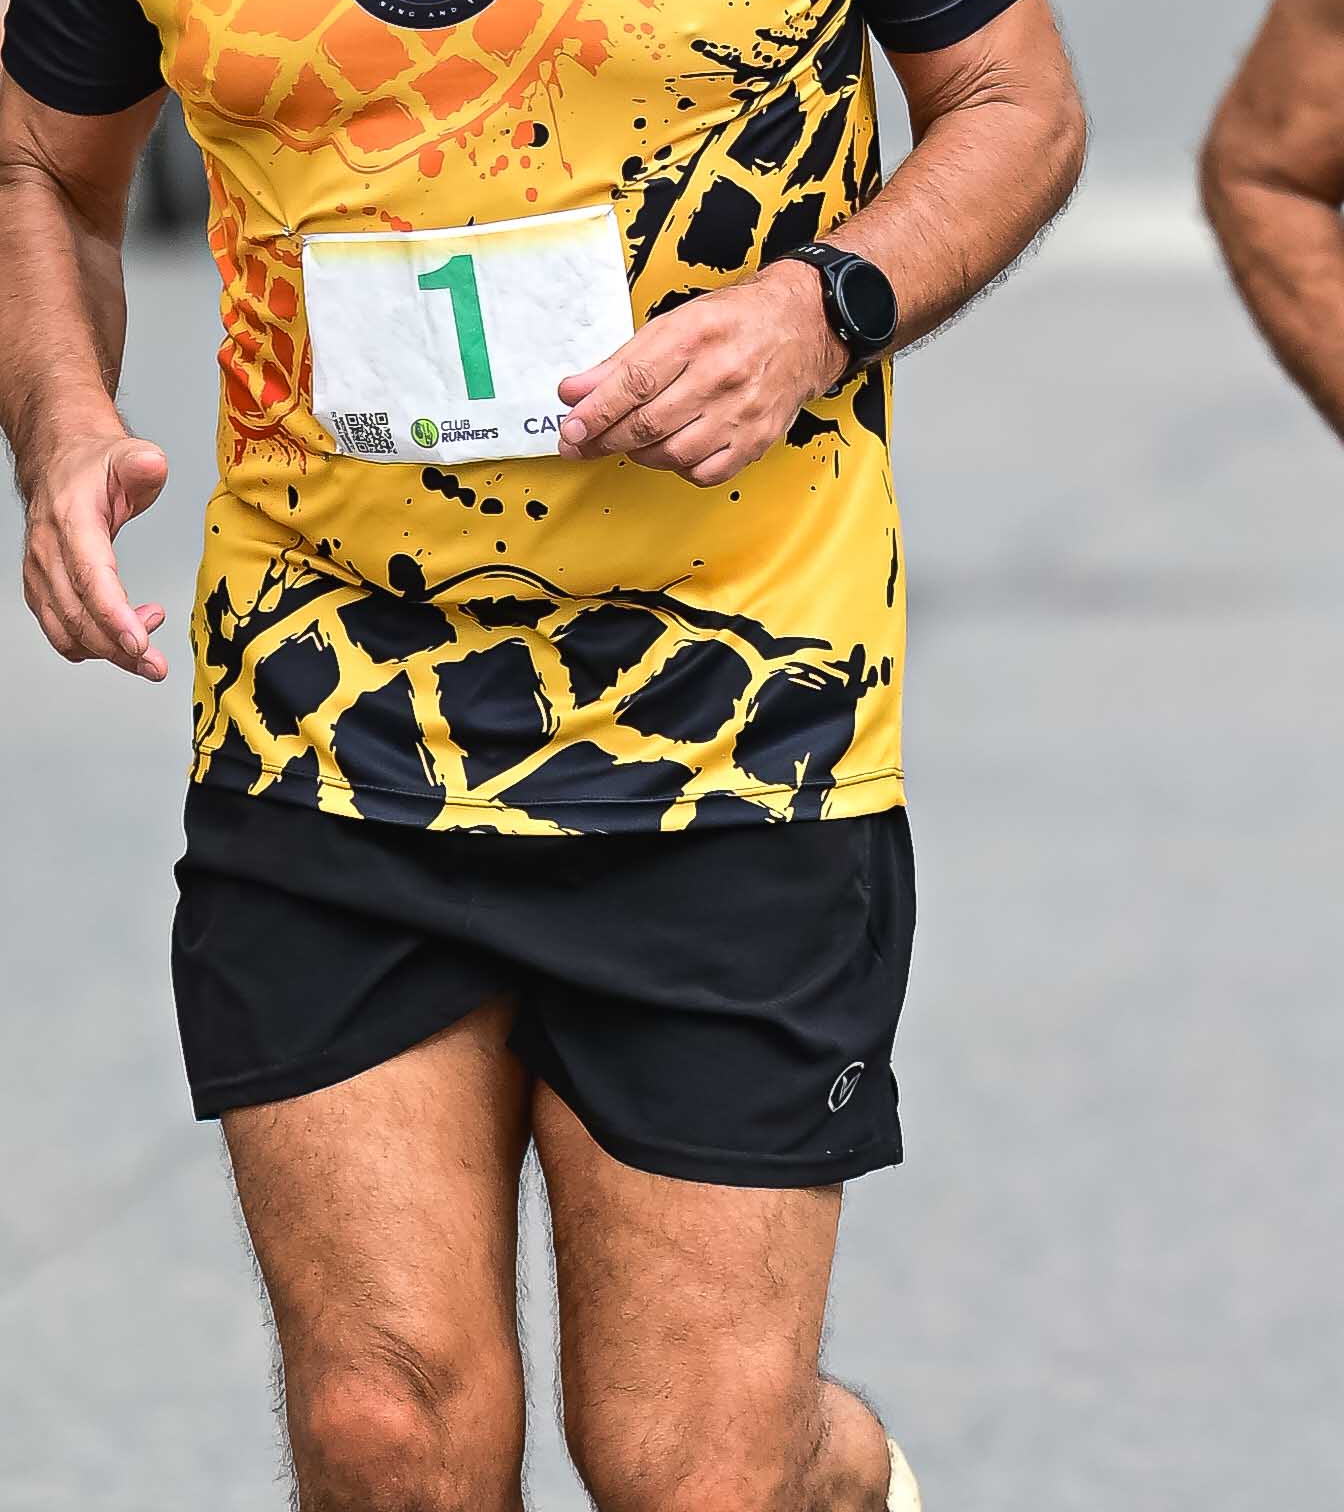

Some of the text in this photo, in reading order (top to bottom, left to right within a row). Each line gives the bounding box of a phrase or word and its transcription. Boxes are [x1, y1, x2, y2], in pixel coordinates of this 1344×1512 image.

[417, 254, 496, 401] 1
[440, 419, 471, 431] CLUB
[441, 427, 499, 443] RUNNER'S
